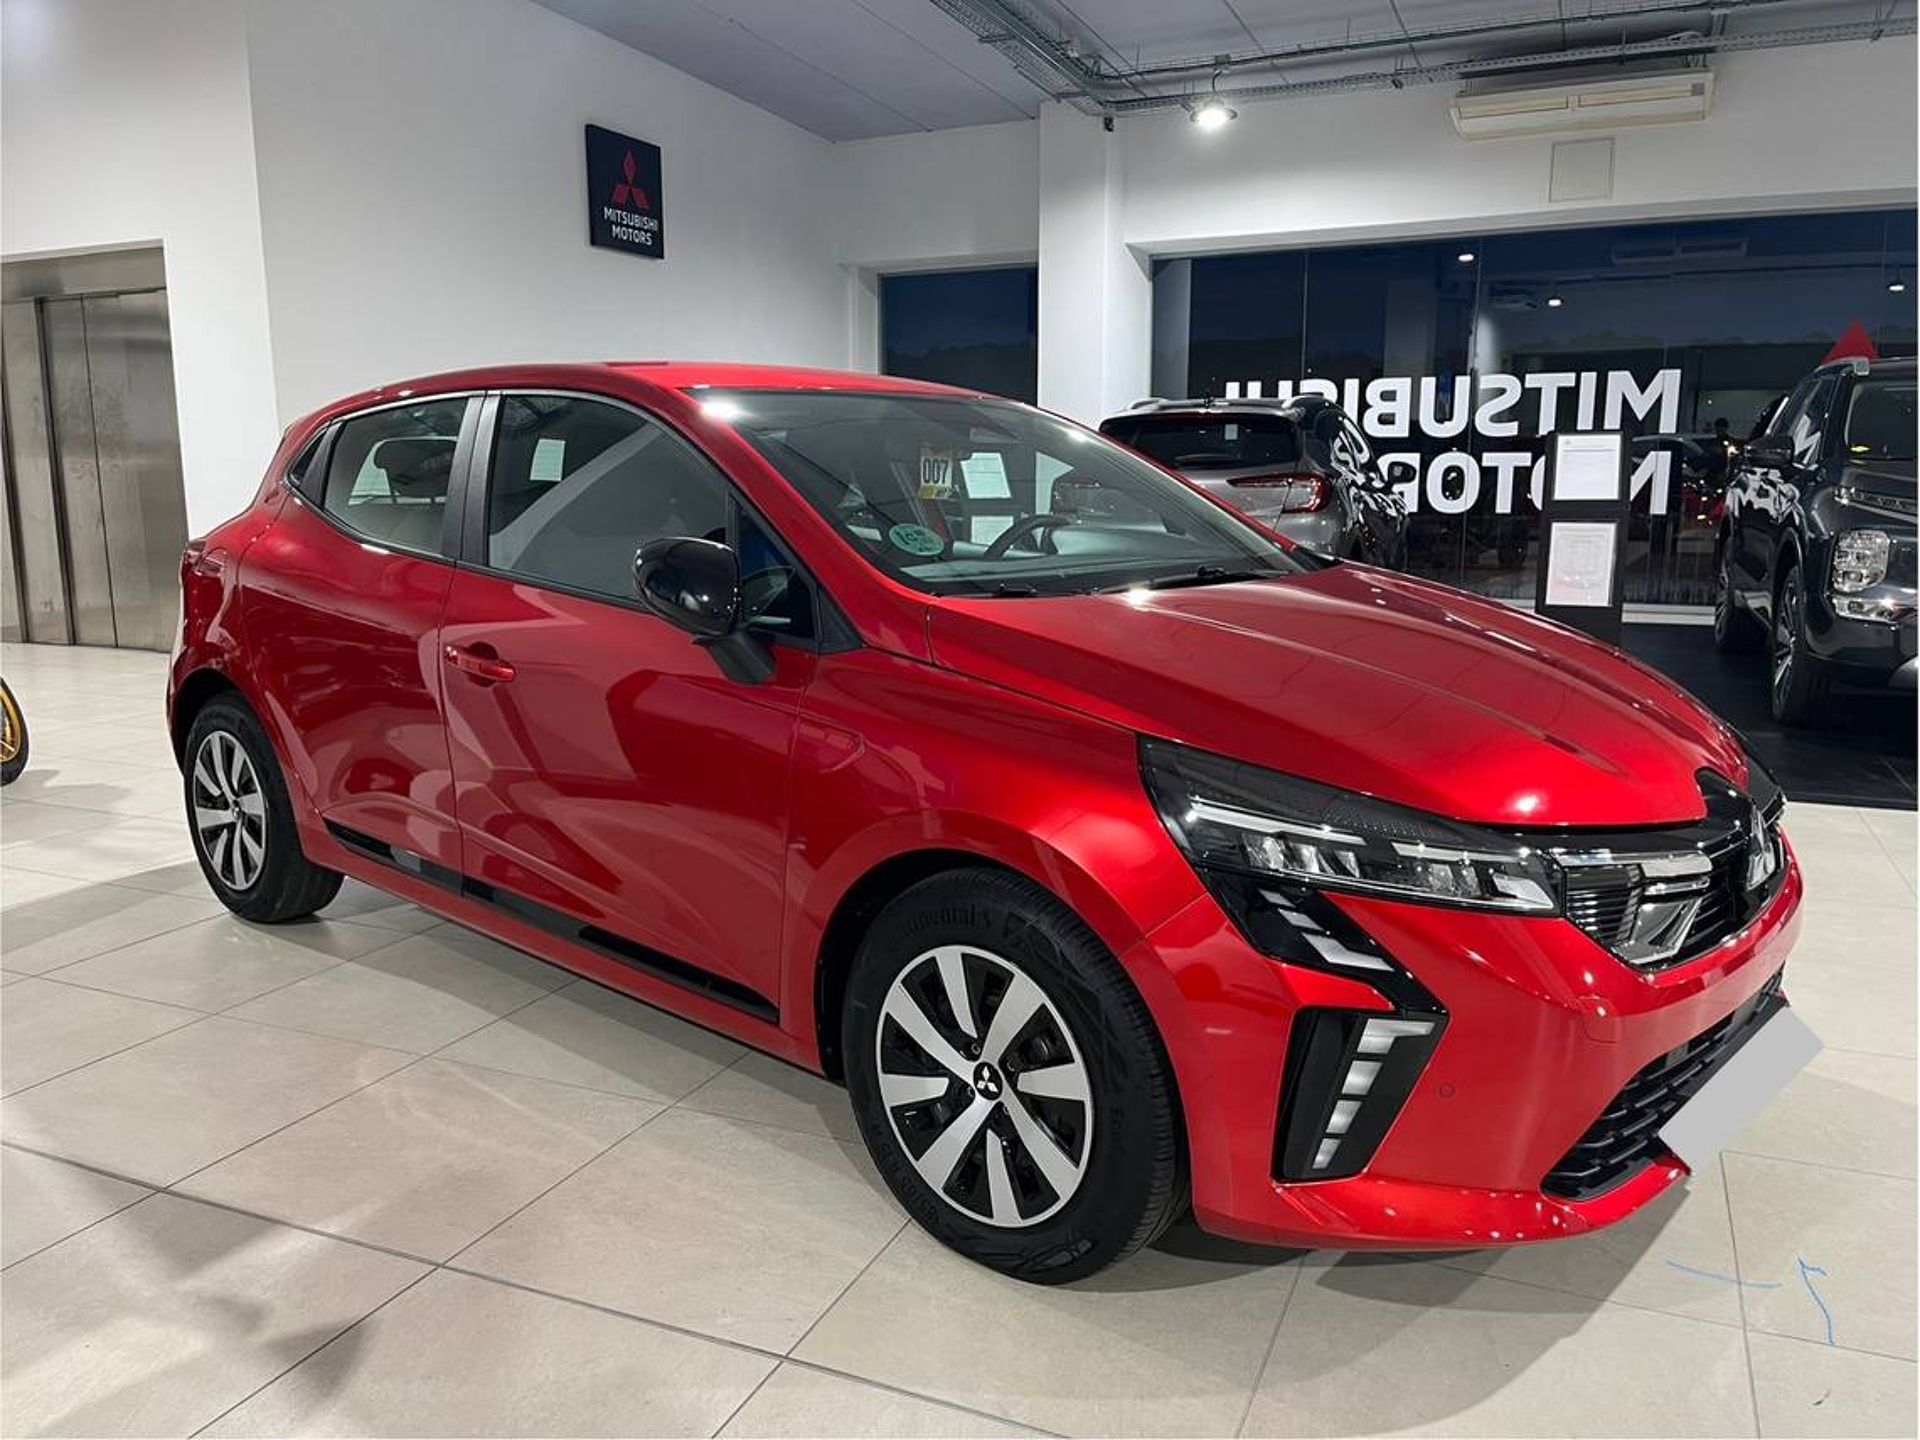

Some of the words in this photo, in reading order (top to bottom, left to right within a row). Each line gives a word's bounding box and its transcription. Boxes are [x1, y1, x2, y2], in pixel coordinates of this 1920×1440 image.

[604, 205, 658, 231] MITSUBISHI
[612, 224, 652, 246] MOTORS
[922, 457, 949, 484] 007
